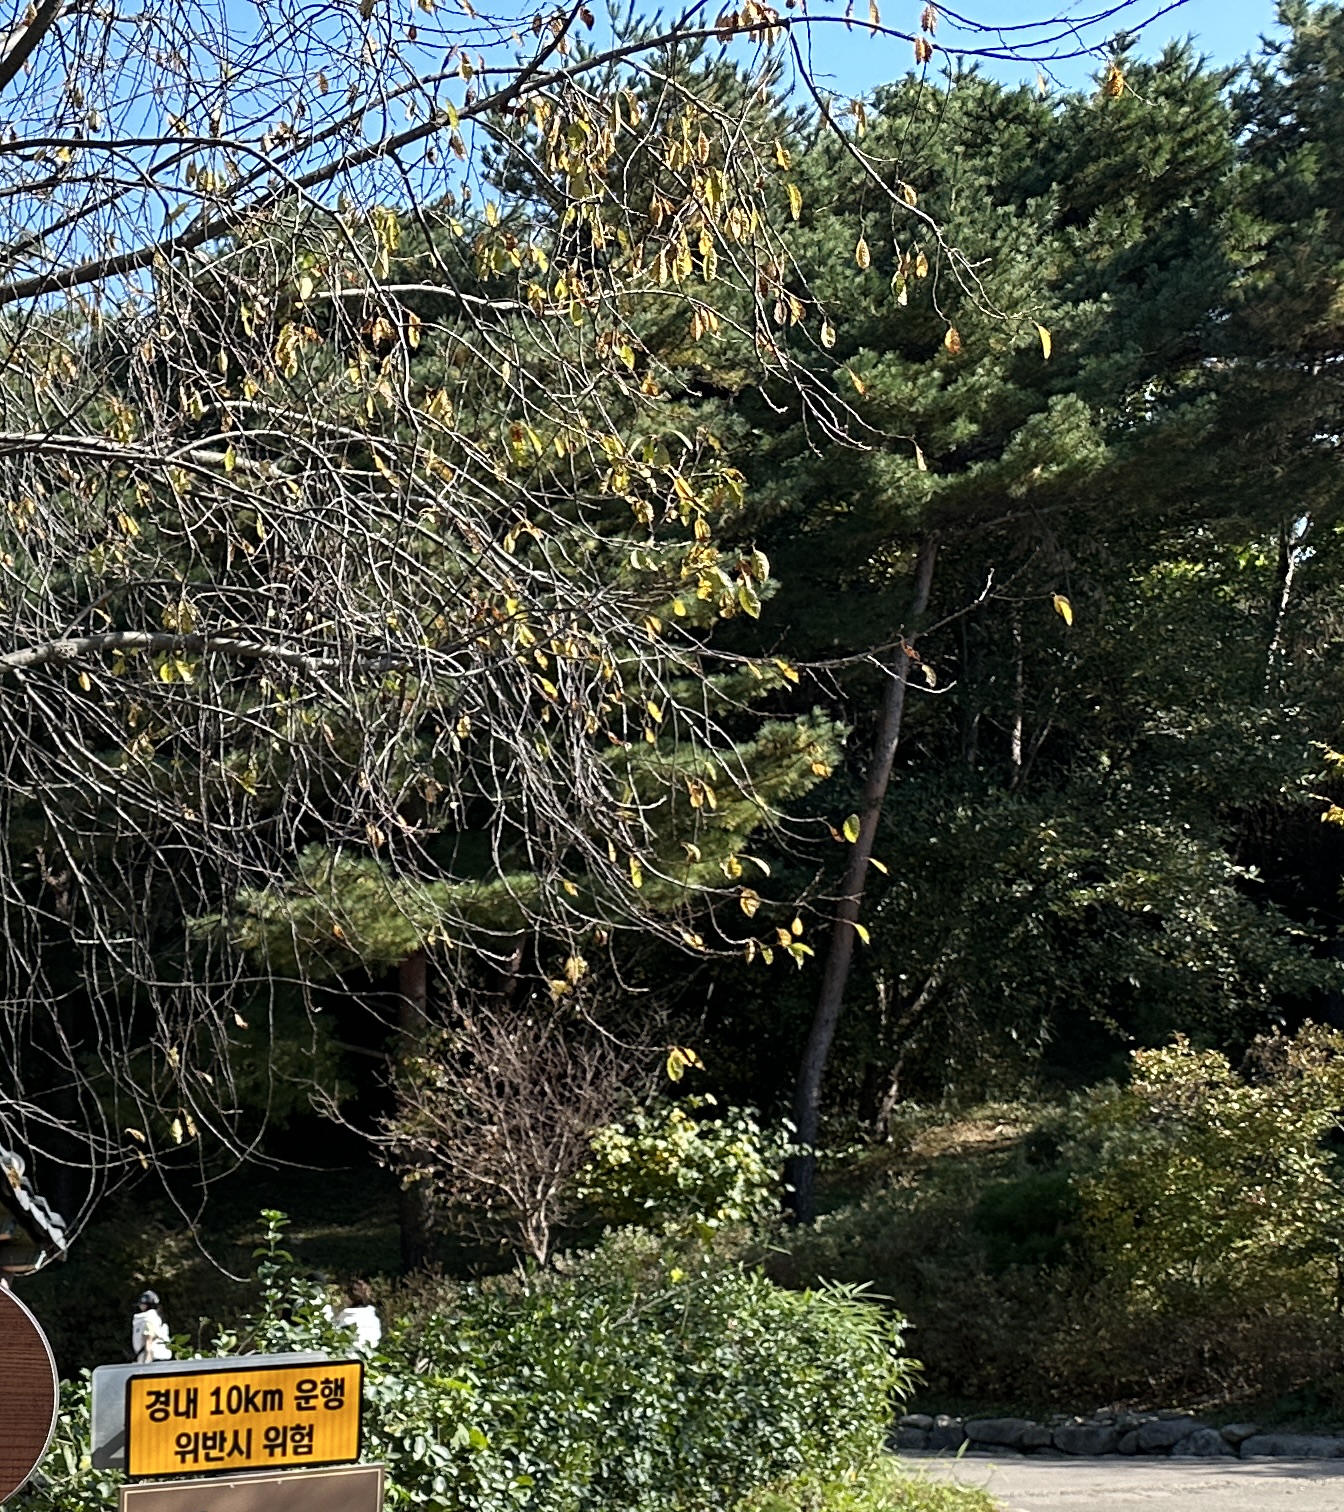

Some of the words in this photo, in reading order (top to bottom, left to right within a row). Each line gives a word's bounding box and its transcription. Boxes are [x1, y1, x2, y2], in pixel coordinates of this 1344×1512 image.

[145, 1387, 199, 1423] 경내
[210, 1384, 284, 1416] 10km
[294, 1377, 346, 1411] 운행
[174, 1428, 253, 1464] 위반시
[262, 1424, 315, 1458] 위험
